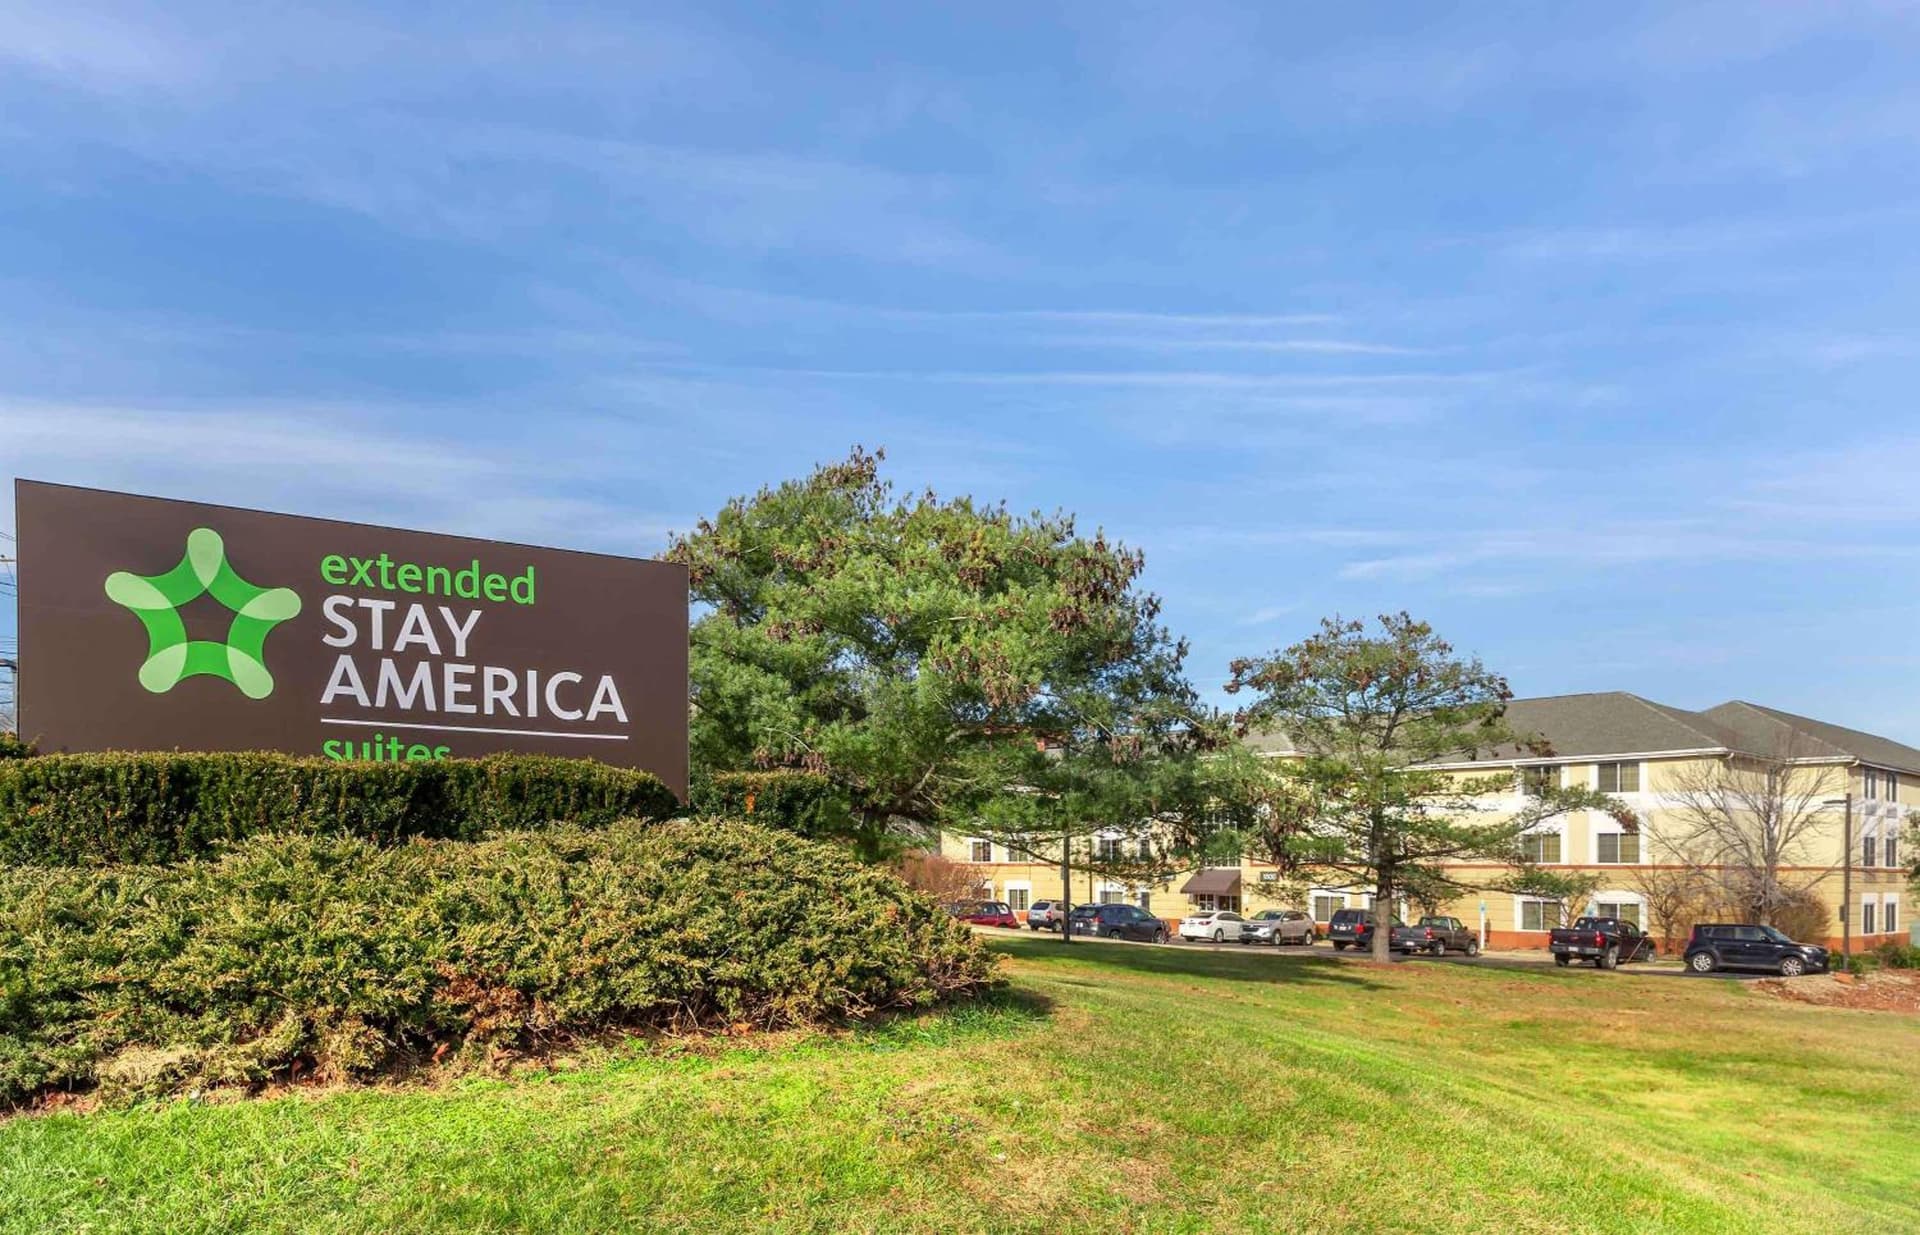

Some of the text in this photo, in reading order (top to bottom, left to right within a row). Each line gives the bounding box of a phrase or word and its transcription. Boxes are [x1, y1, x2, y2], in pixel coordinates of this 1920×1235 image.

[320, 553, 535, 605] extended
[322, 595, 482, 657] STAY
[320, 654, 628, 722] AMERICA
